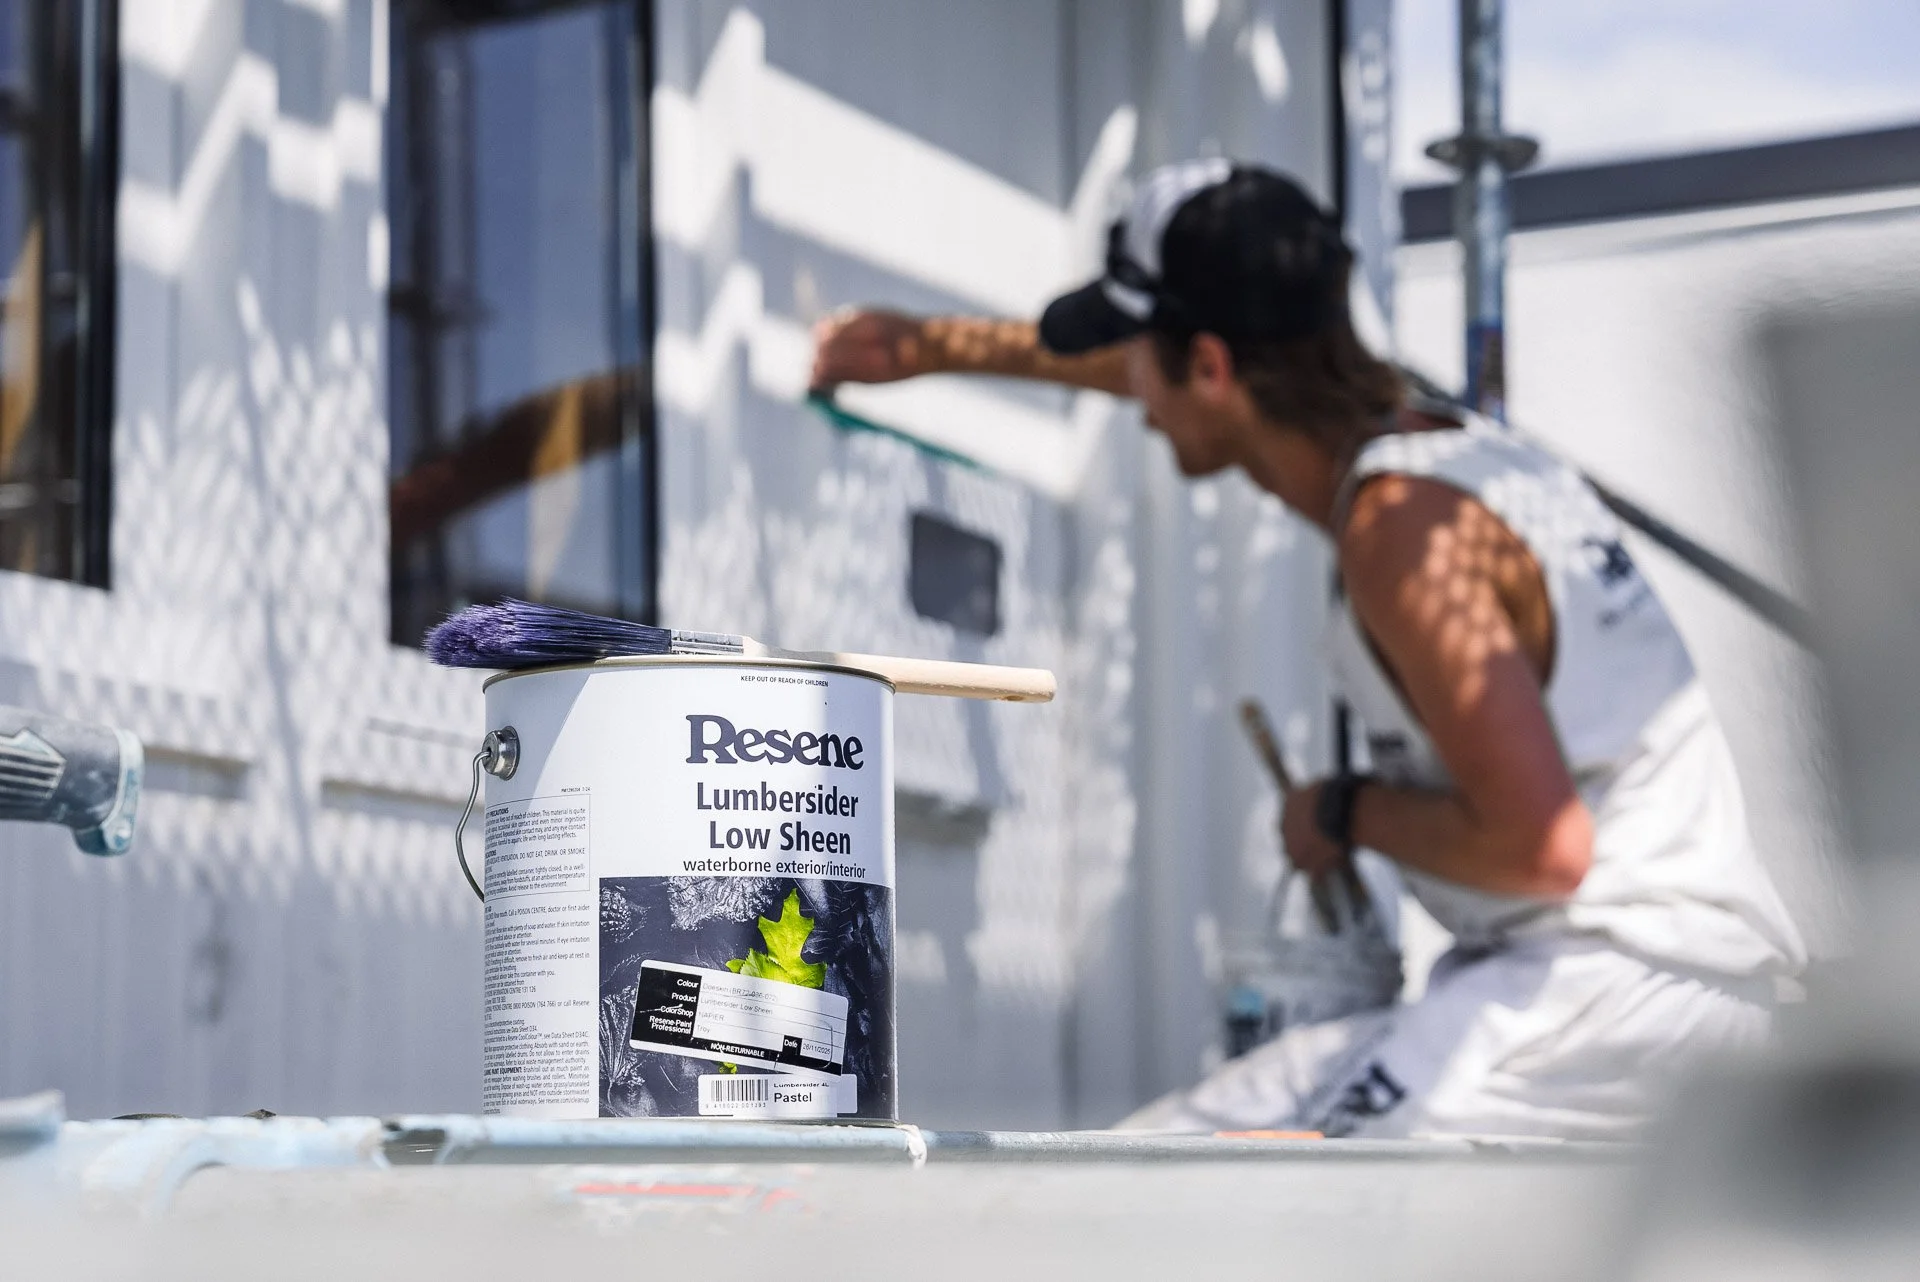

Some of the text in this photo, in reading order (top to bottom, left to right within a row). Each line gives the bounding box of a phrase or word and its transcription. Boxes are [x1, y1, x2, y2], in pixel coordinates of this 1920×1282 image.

[804, 679, 829, 687] CHILDREN
[686, 714, 864, 770] Resene
[697, 781, 858, 818] Lumbersider
[547, 833, 560, 841] lasting
[710, 820, 851, 854] Low Sheen
[683, 857, 866, 878] waterborne exterior/interior
[676, 978, 699, 988] Colour
[672, 992, 697, 1002] Product
[660, 1006, 694, 1018] ColorShop
[700, 998, 773, 1015] Lumbersider Low Sheen
[650, 1016, 692, 1028] Resene Paint
[652, 1022, 692, 1034] Professional
[784, 1039, 798, 1048] Date
[710, 1042, 765, 1058] NON-RETURNABLE
[774, 1092, 812, 1103] Pastel
